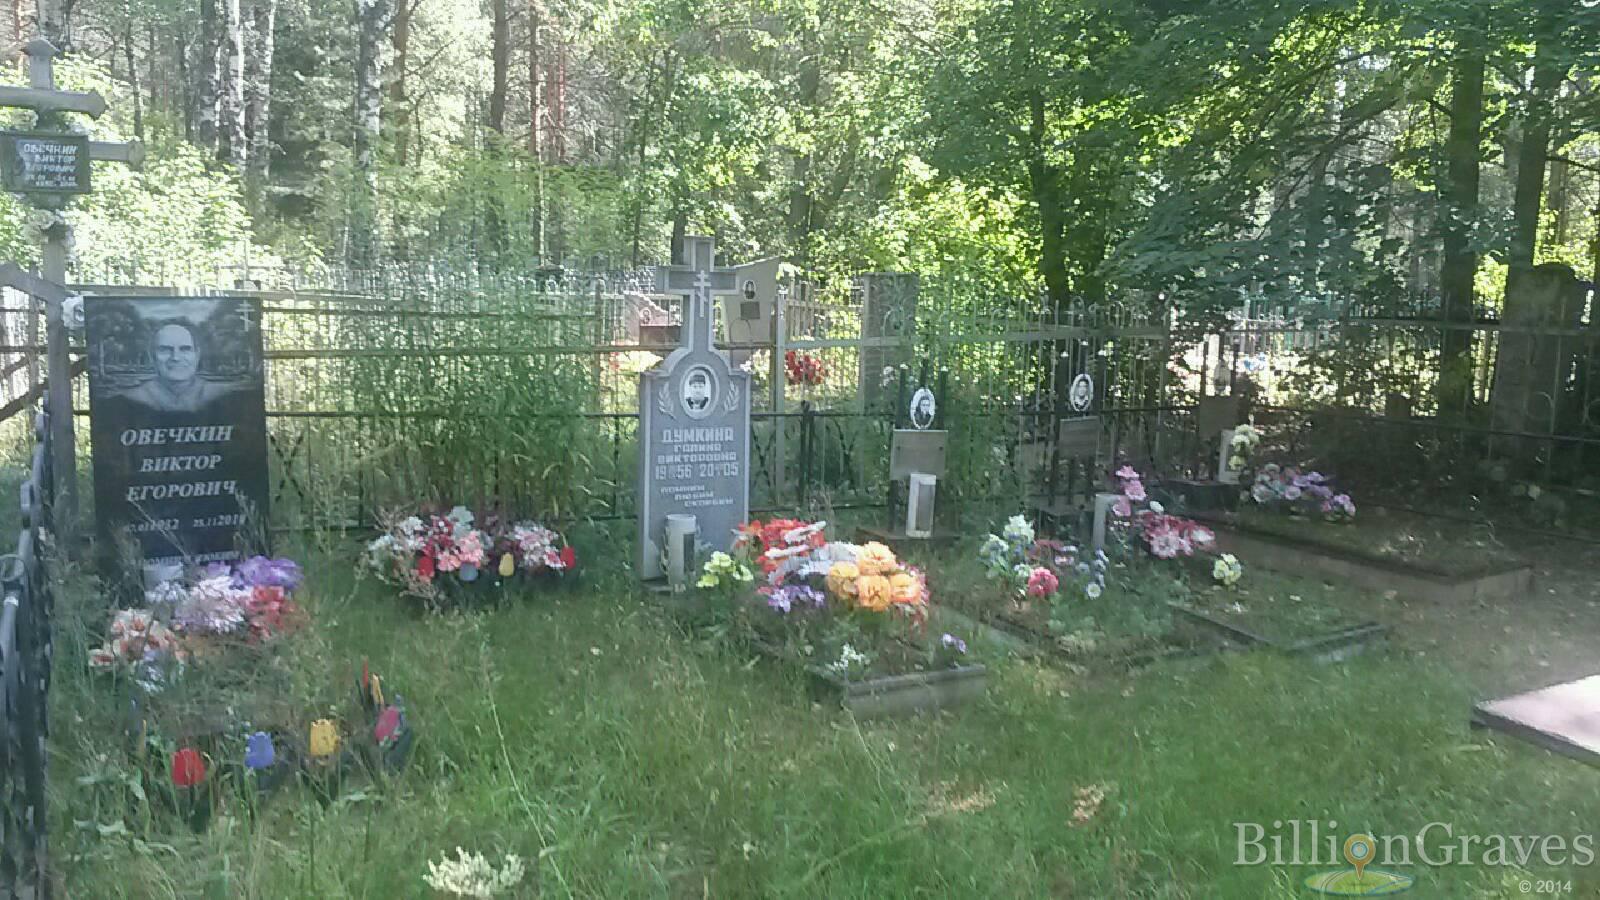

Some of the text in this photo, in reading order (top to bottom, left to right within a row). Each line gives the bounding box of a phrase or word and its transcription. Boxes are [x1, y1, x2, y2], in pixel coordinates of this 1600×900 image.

[120, 425, 233, 447] ОВЕЧКИН
[662, 426, 734, 443] ДУМКИНА
[140, 454, 222, 473] ВИКТОР
[127, 480, 237, 501] ЕГОРОВИЧ
